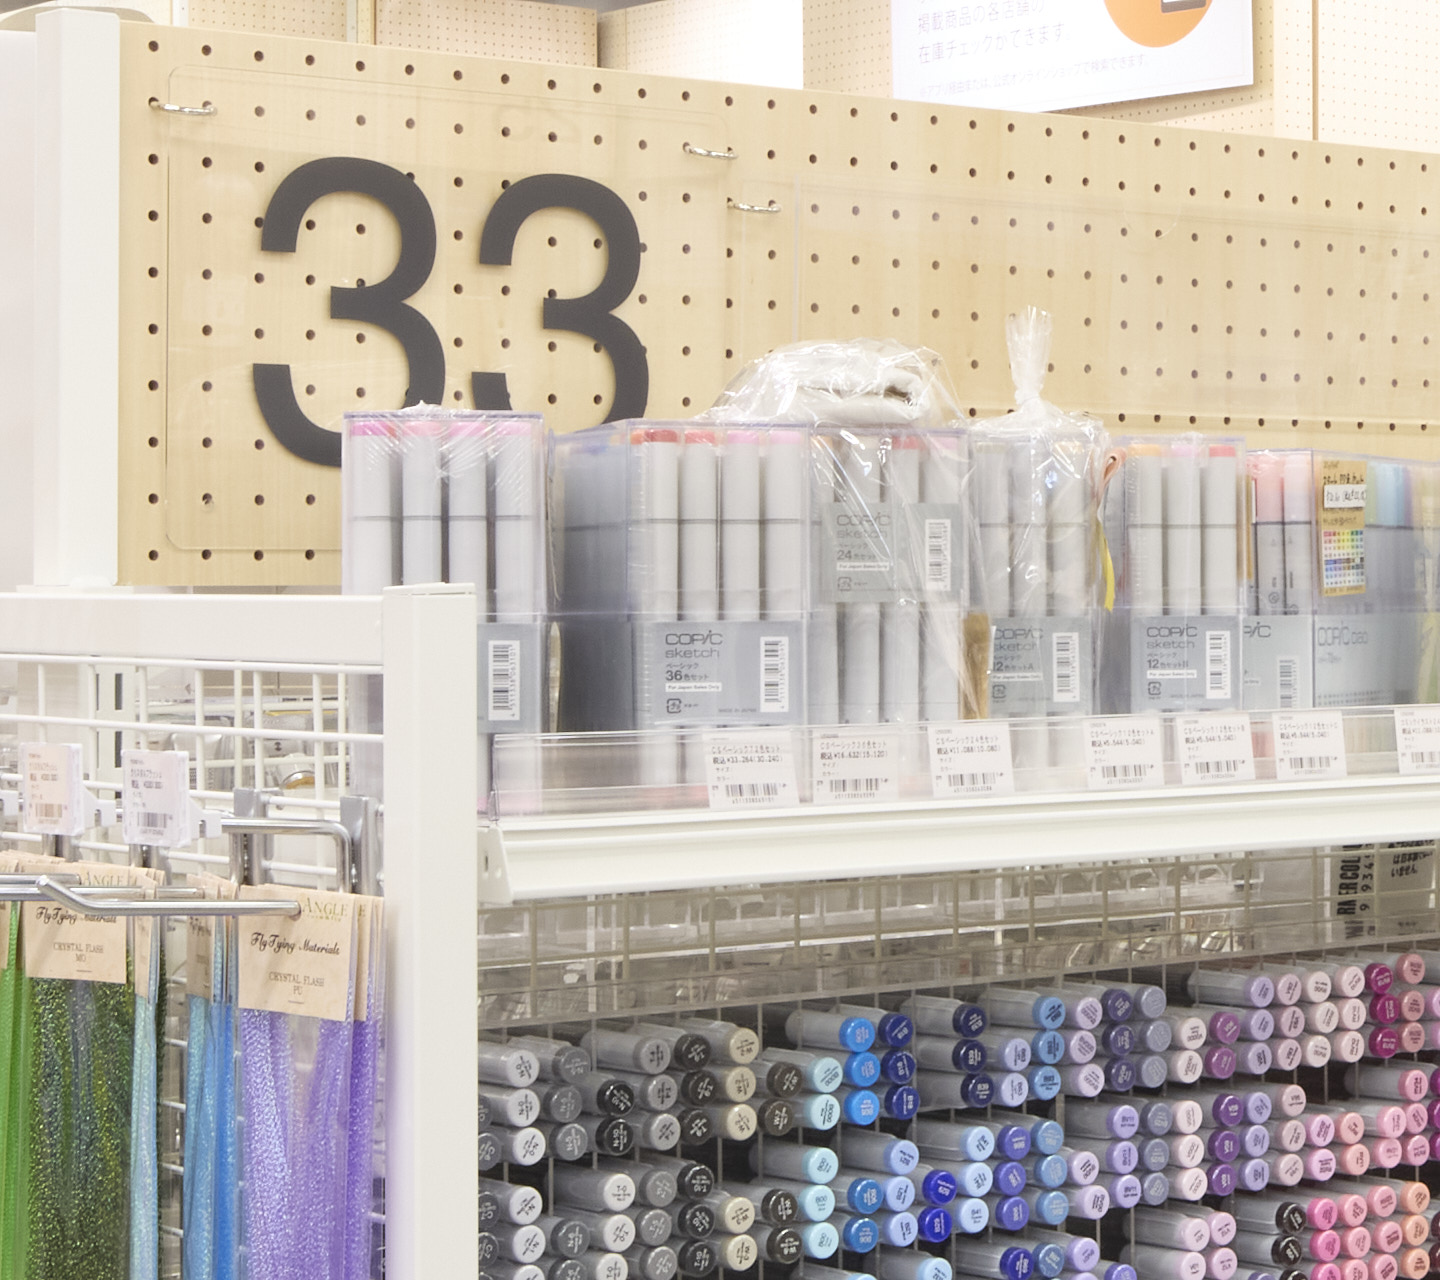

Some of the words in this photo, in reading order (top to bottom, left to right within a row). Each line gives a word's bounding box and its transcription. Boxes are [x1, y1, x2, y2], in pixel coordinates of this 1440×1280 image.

[253, 156, 650, 468] 33
[1146, 621, 1198, 638] COPIC
[665, 630, 724, 646] COPIC
[1146, 639, 1196, 650] sketch
[665, 648, 721, 659] sketch
[665, 661, 700, 671] ベーシック
[665, 670, 710, 682] 36色セット
[302, 896, 348, 916] ANGLE
[297, 939, 340, 956] Materials
[268, 970, 297, 984] CRYSTAL
[300, 975, 325, 988] FLASH
